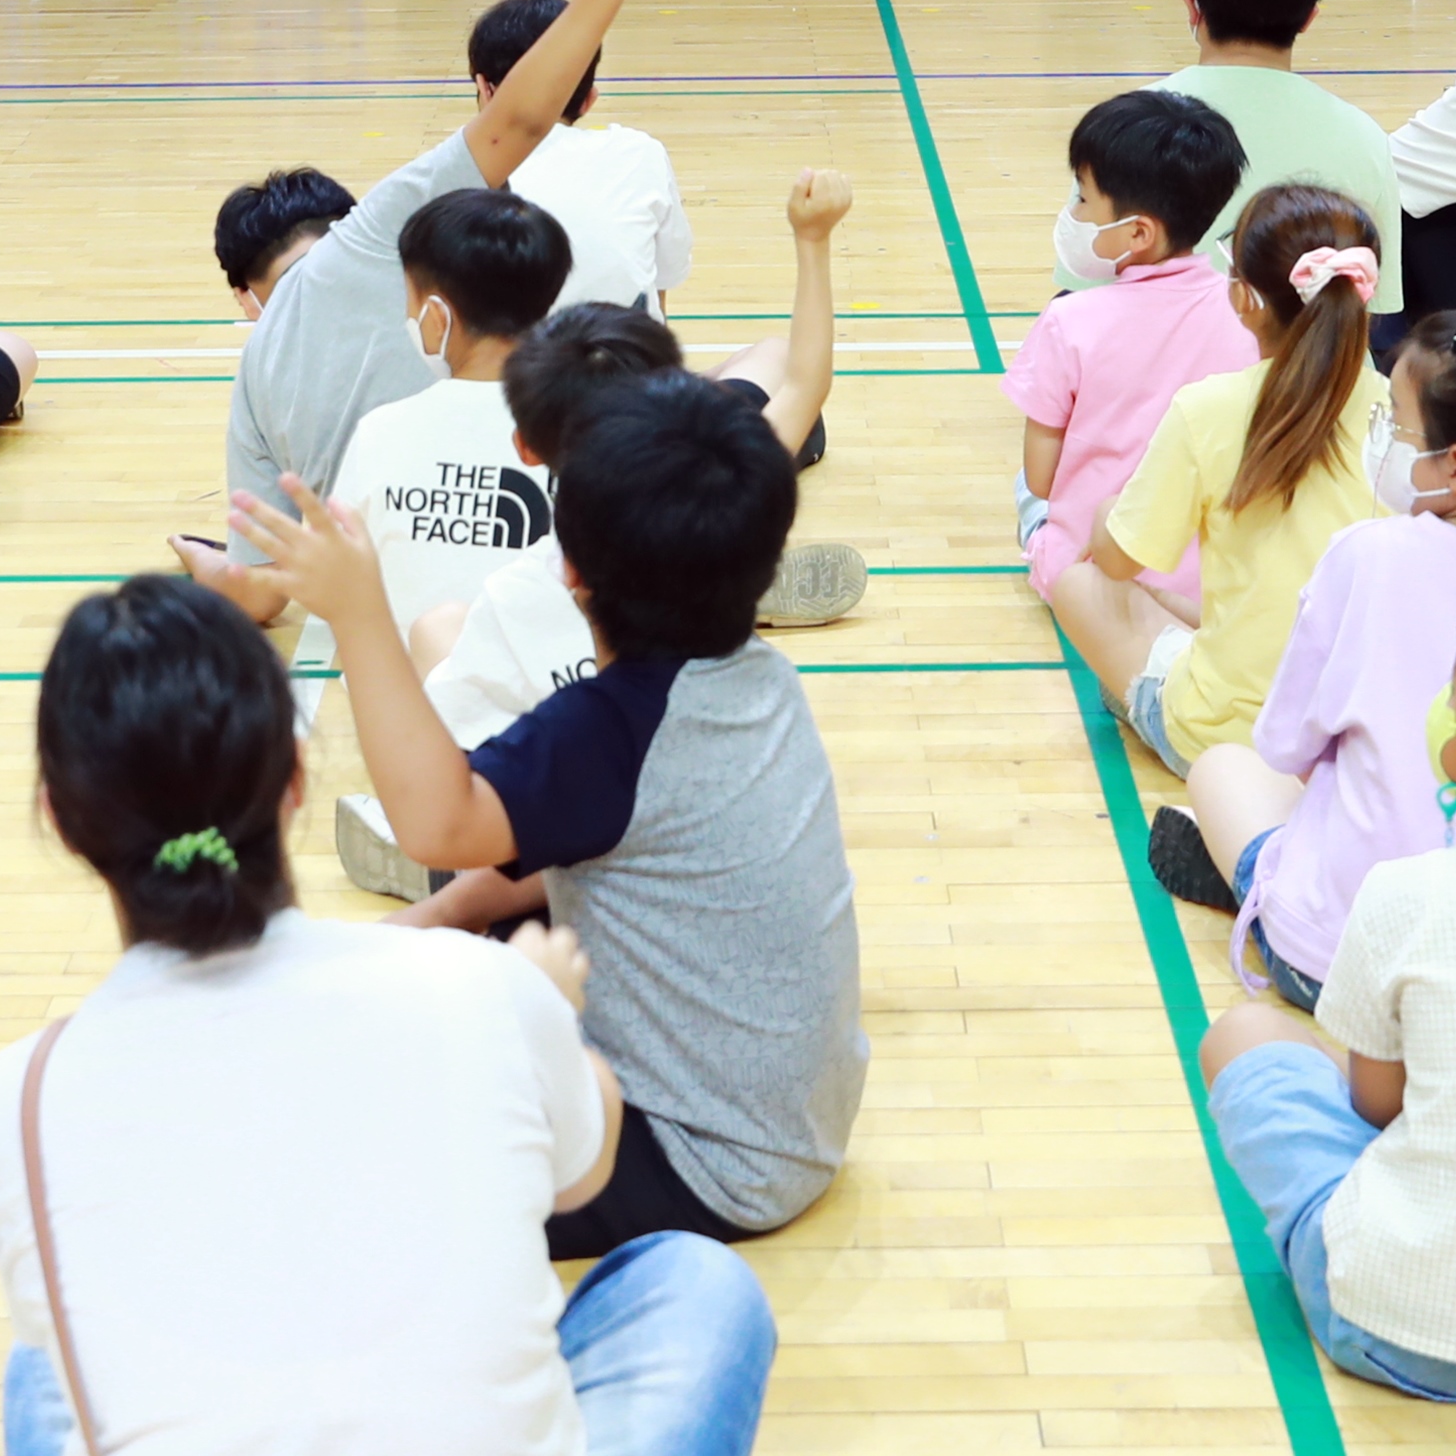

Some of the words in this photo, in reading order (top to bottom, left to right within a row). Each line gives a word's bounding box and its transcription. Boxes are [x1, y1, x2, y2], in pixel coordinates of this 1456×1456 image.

[437, 461, 497, 490] THE
[385, 486, 494, 518] NORTH
[411, 516, 490, 547] FACE
